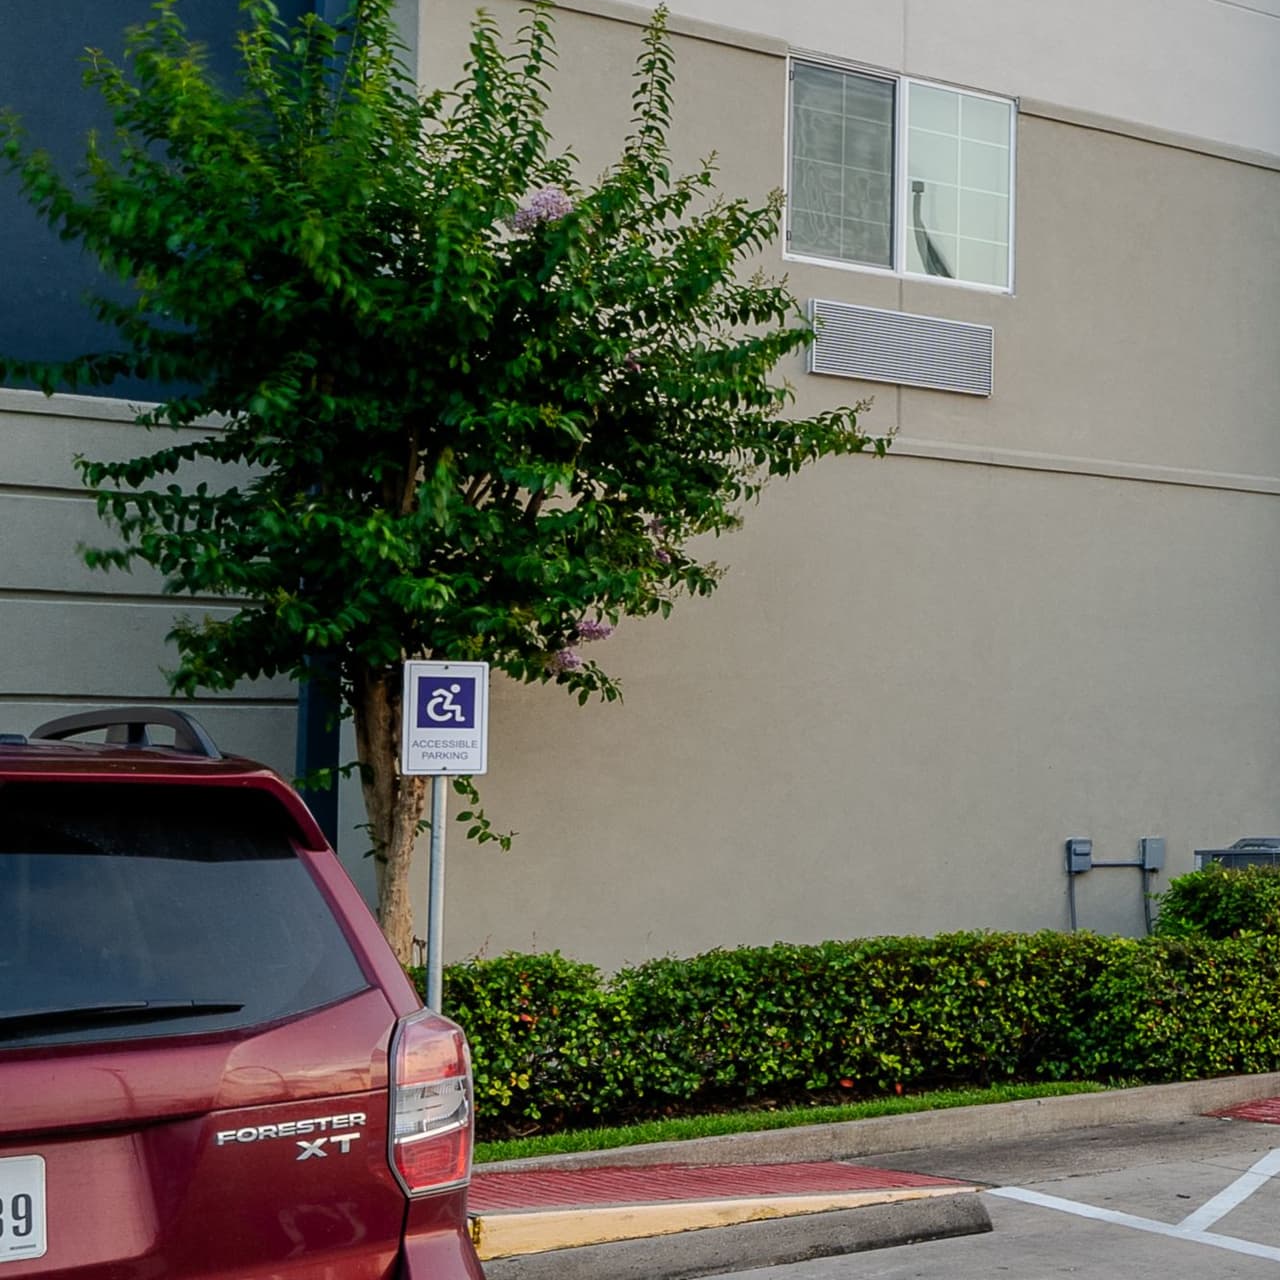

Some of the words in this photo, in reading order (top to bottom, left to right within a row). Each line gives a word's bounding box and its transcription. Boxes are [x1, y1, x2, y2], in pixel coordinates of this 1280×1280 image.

[411, 739, 479, 749] ACCESSIBLE
[422, 751, 469, 760] PARKING
[216, 1112, 367, 1145] FORESTER
[295, 1132, 361, 1160] XT
